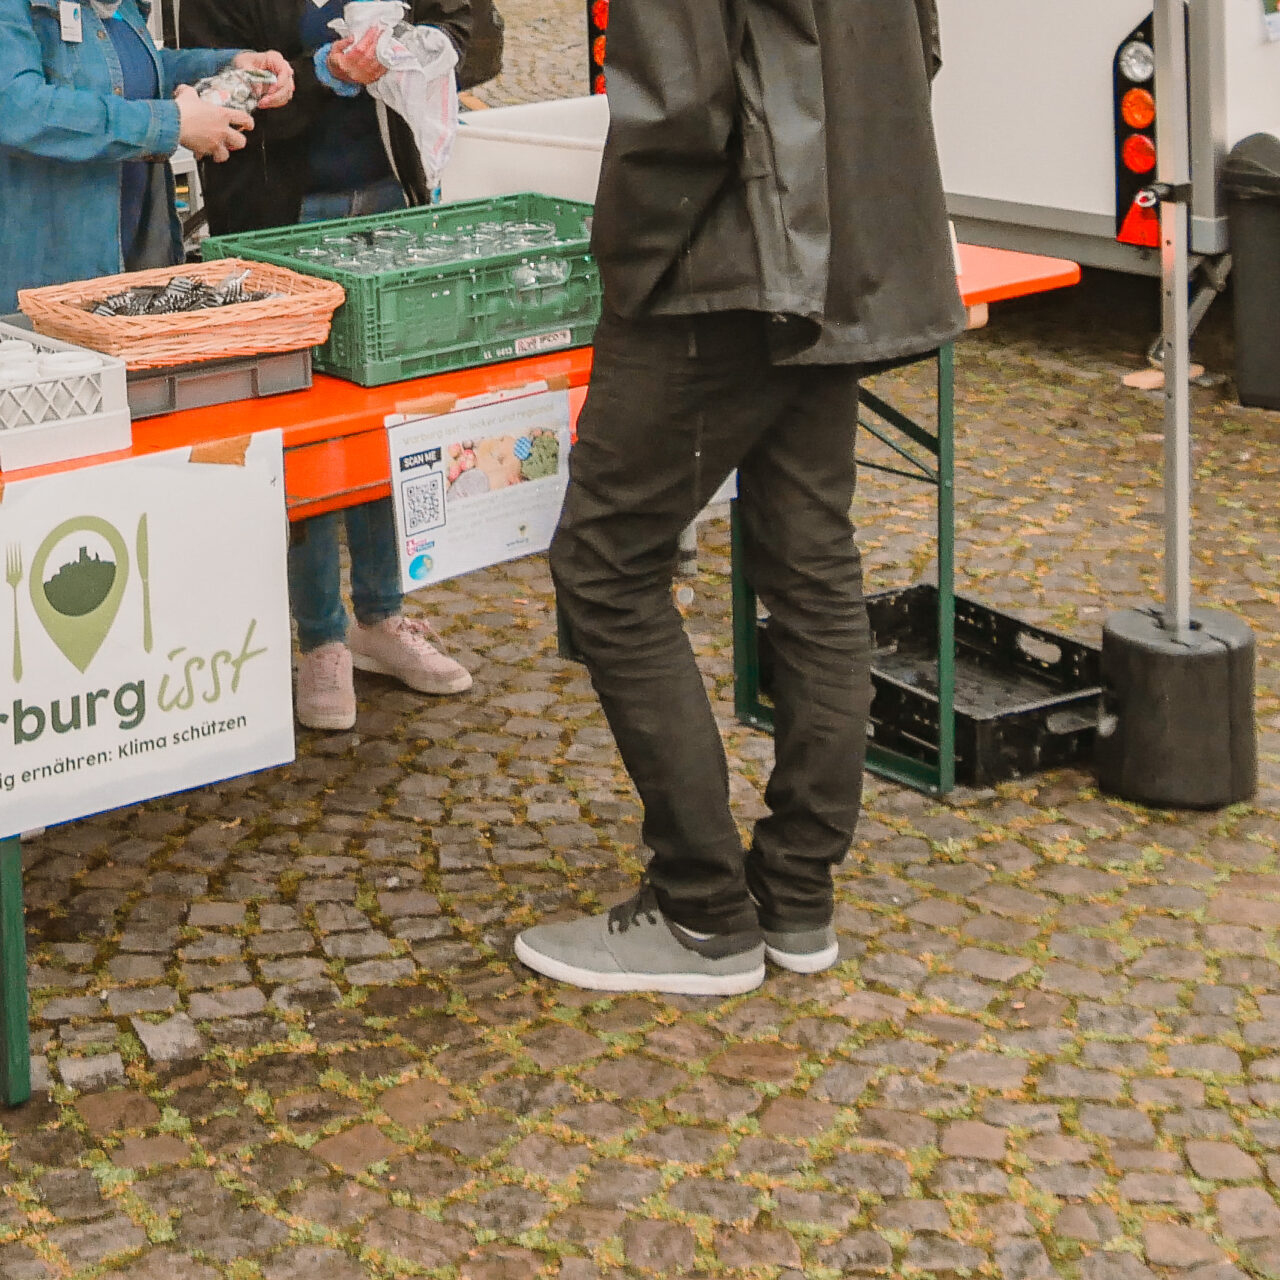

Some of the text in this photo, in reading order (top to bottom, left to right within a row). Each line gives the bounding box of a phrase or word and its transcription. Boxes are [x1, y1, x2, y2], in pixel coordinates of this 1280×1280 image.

[403, 451, 438, 469] SCAN ME
[158, 618, 268, 712] isst
[22, 748, 113, 783] ernähren:
[117, 735, 167, 759] Klima
[173, 714, 247, 745] schützen
